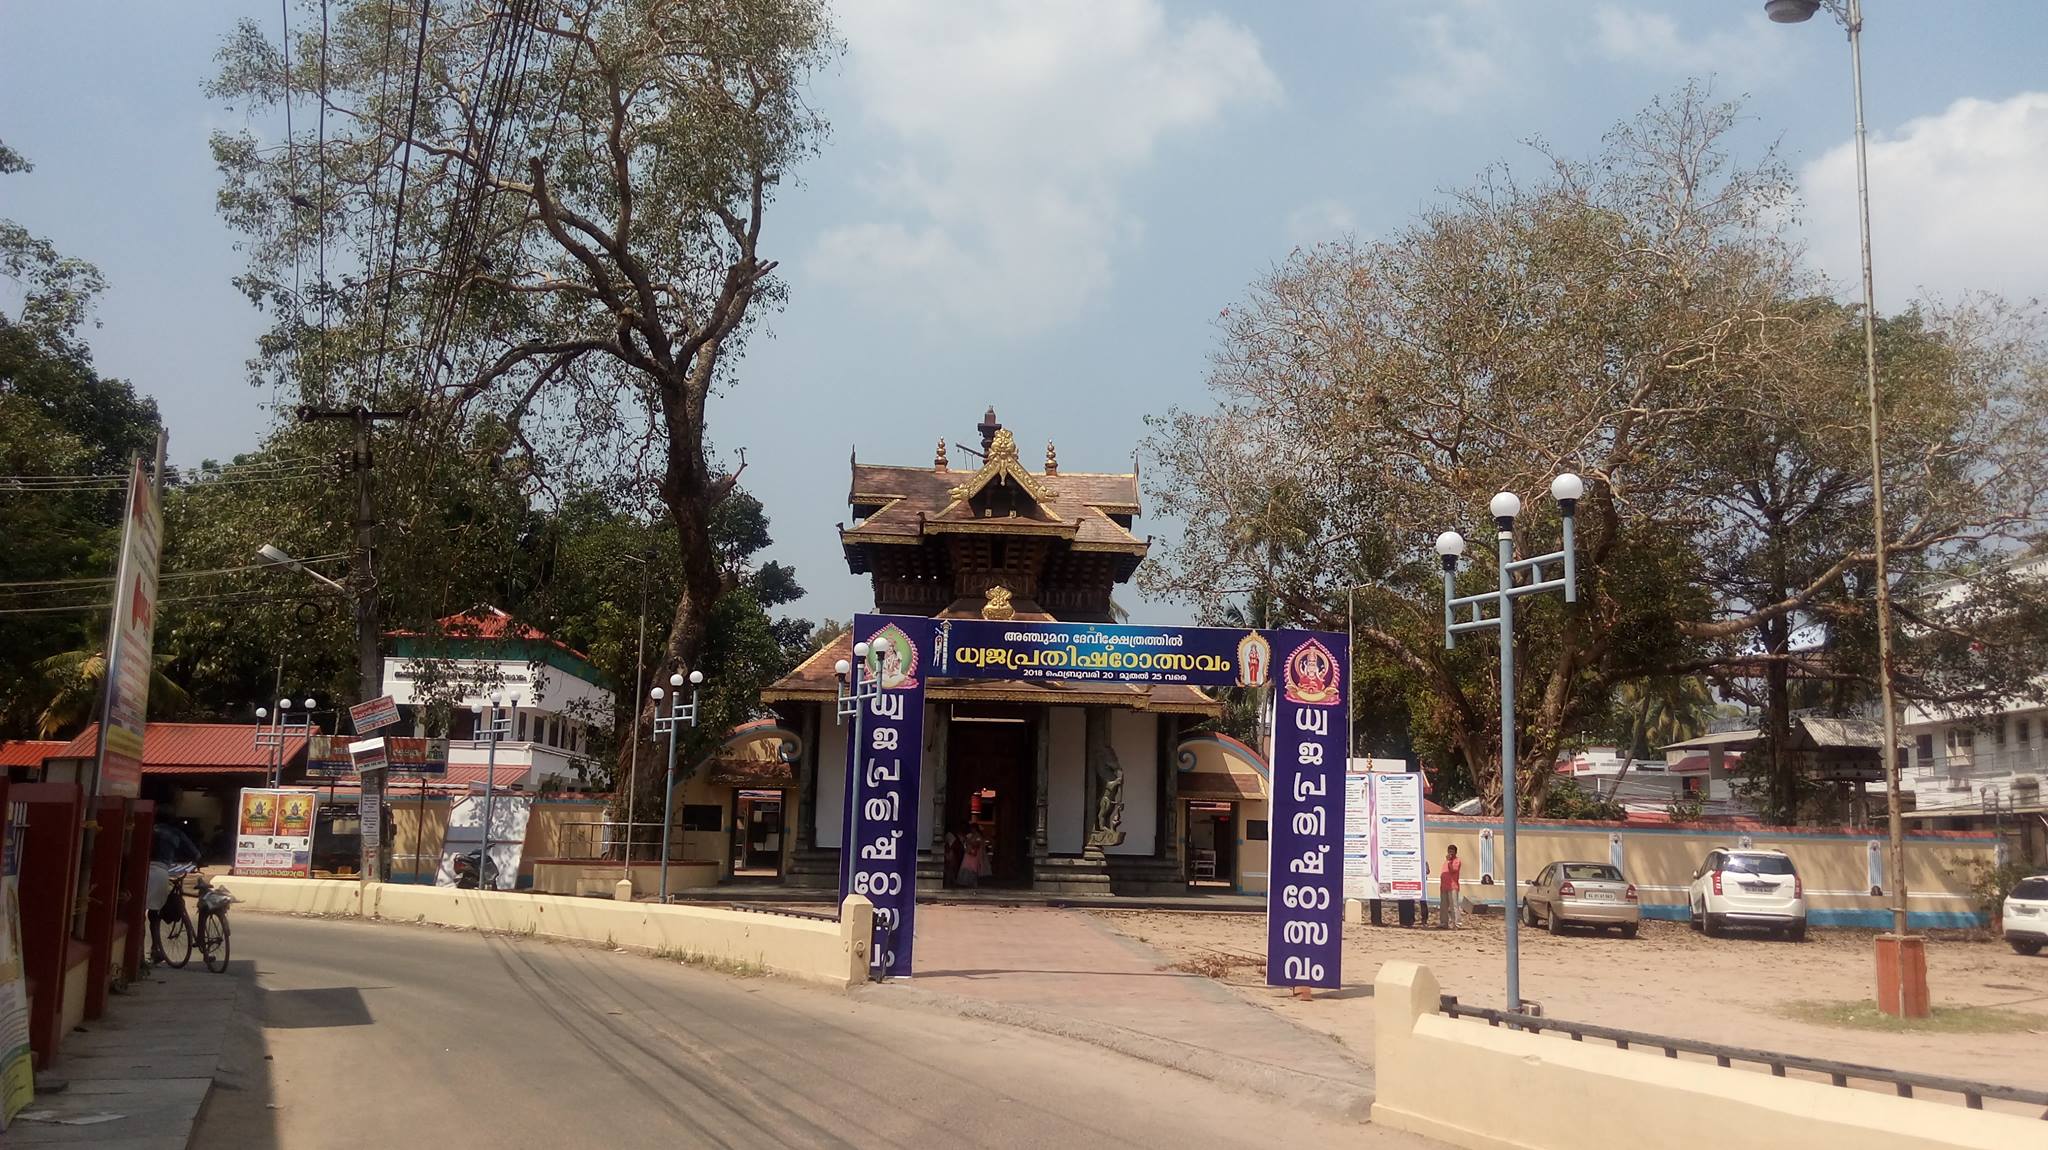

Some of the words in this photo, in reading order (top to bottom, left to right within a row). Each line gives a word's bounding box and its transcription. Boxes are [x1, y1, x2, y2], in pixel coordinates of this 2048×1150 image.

[1004, 631, 1069, 645] അഞ്ചുമന
[1073, 632, 1183, 648] ദേവീക്ഷേത്രത്തിൽ
[955, 644, 1231, 671] ധ്വജപ്രതിഷ്ഠോത്സവം
[1046, 670, 1100, 679] ഫെബ്രുവരി
[1119, 672, 1149, 681] മുതൽ
